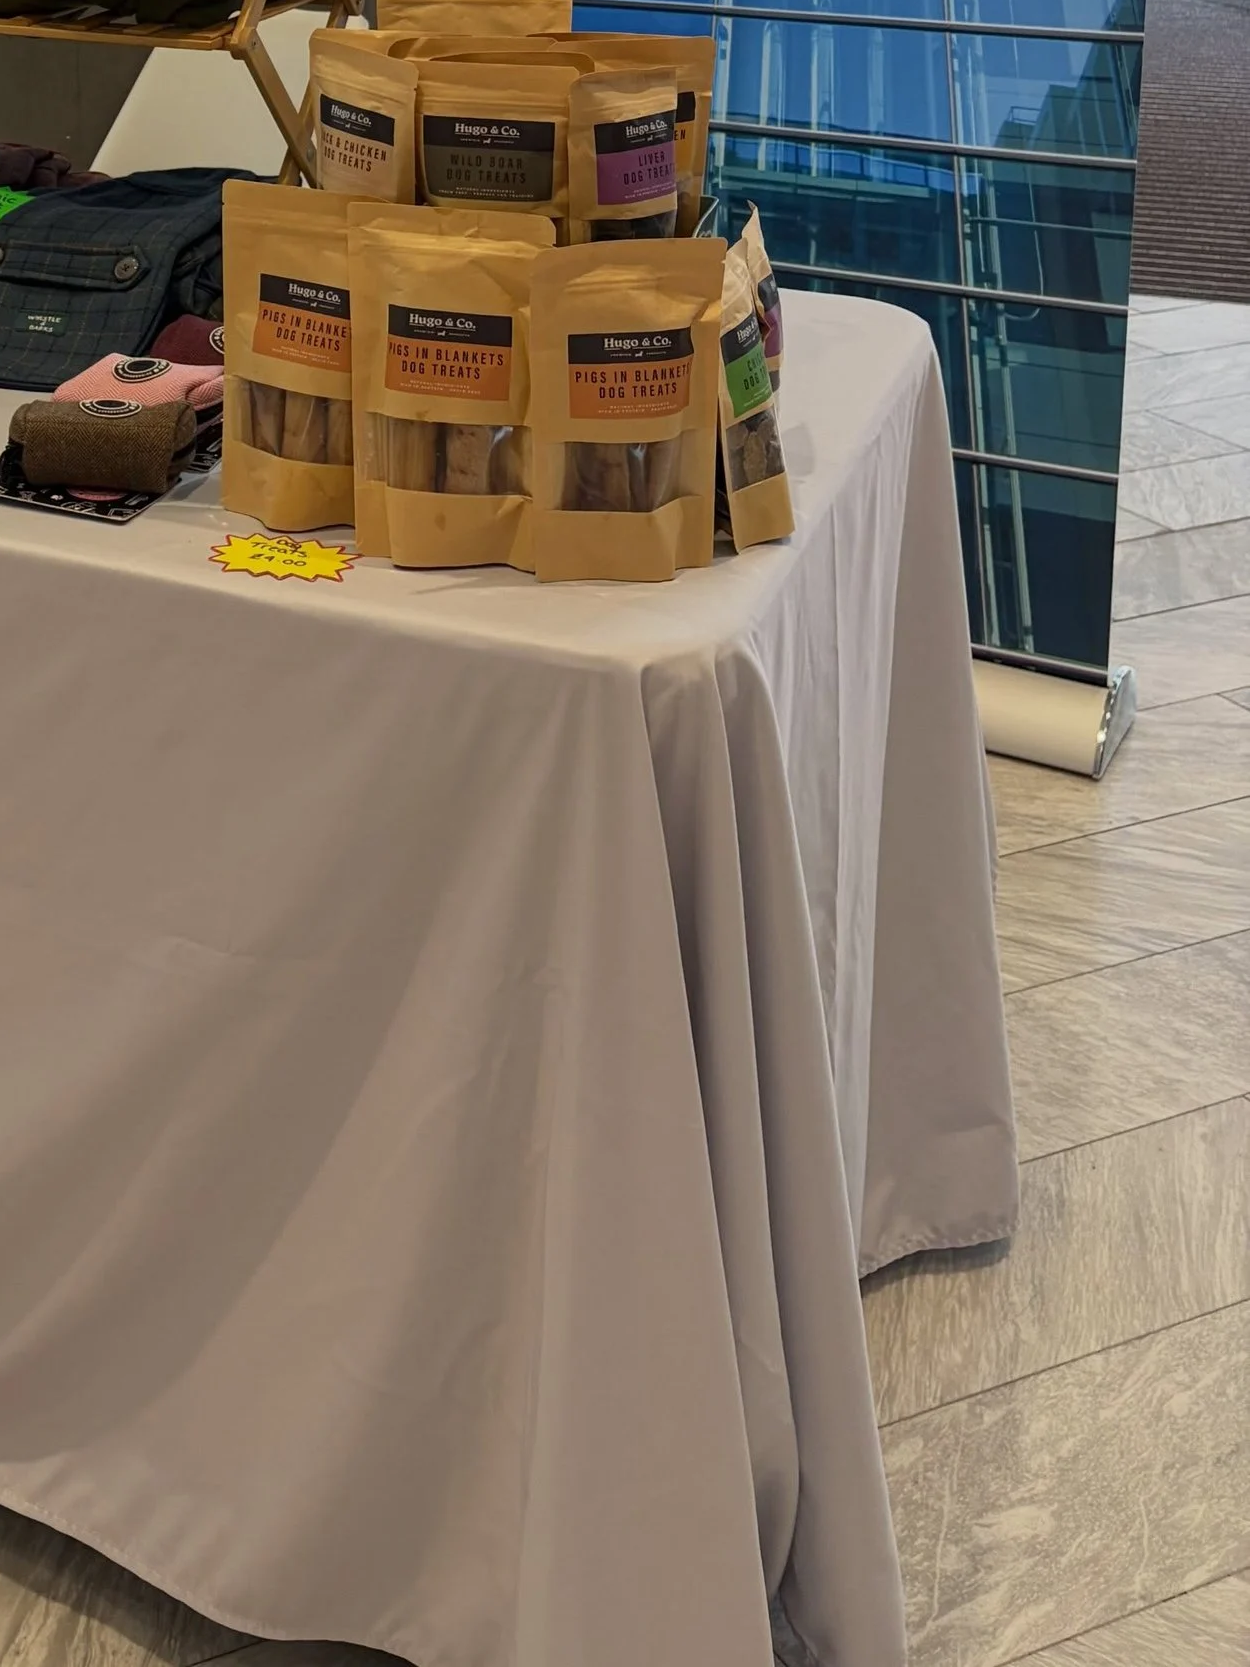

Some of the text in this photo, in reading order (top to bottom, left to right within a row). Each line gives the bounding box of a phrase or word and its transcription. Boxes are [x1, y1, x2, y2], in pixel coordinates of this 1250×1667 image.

[331, 104, 350, 119] Hugo
[357, 113, 372, 125] Co.
[455, 123, 520, 136] Hugo & Co.
[625, 119, 668, 136] Hugo & Co.
[344, 140, 387, 162] CHICKEN
[639, 151, 665, 167] LIVER
[338, 152, 372, 172] TREATS
[450, 154, 523, 170] WILD BOAR
[446, 168, 526, 184] DOG TREATS
[623, 170, 644, 185] DOG
[288, 283, 341, 303] Hugo & Co.
[262, 309, 350, 339] PIGS IN BLANKE
[409, 313, 476, 329] Hugo & Co.
[276, 327, 340, 352] DOG TREATS
[604, 336, 672, 349] Hugo & Co.
[416, 347, 429, 359] IN
[436, 349, 504, 366] BLANKETS
[402, 360, 481, 380] DOG TREATS
[575, 371, 607, 384] PIGS
[614, 371, 627, 383] IN
[599, 382, 677, 399] DOG TREATS
